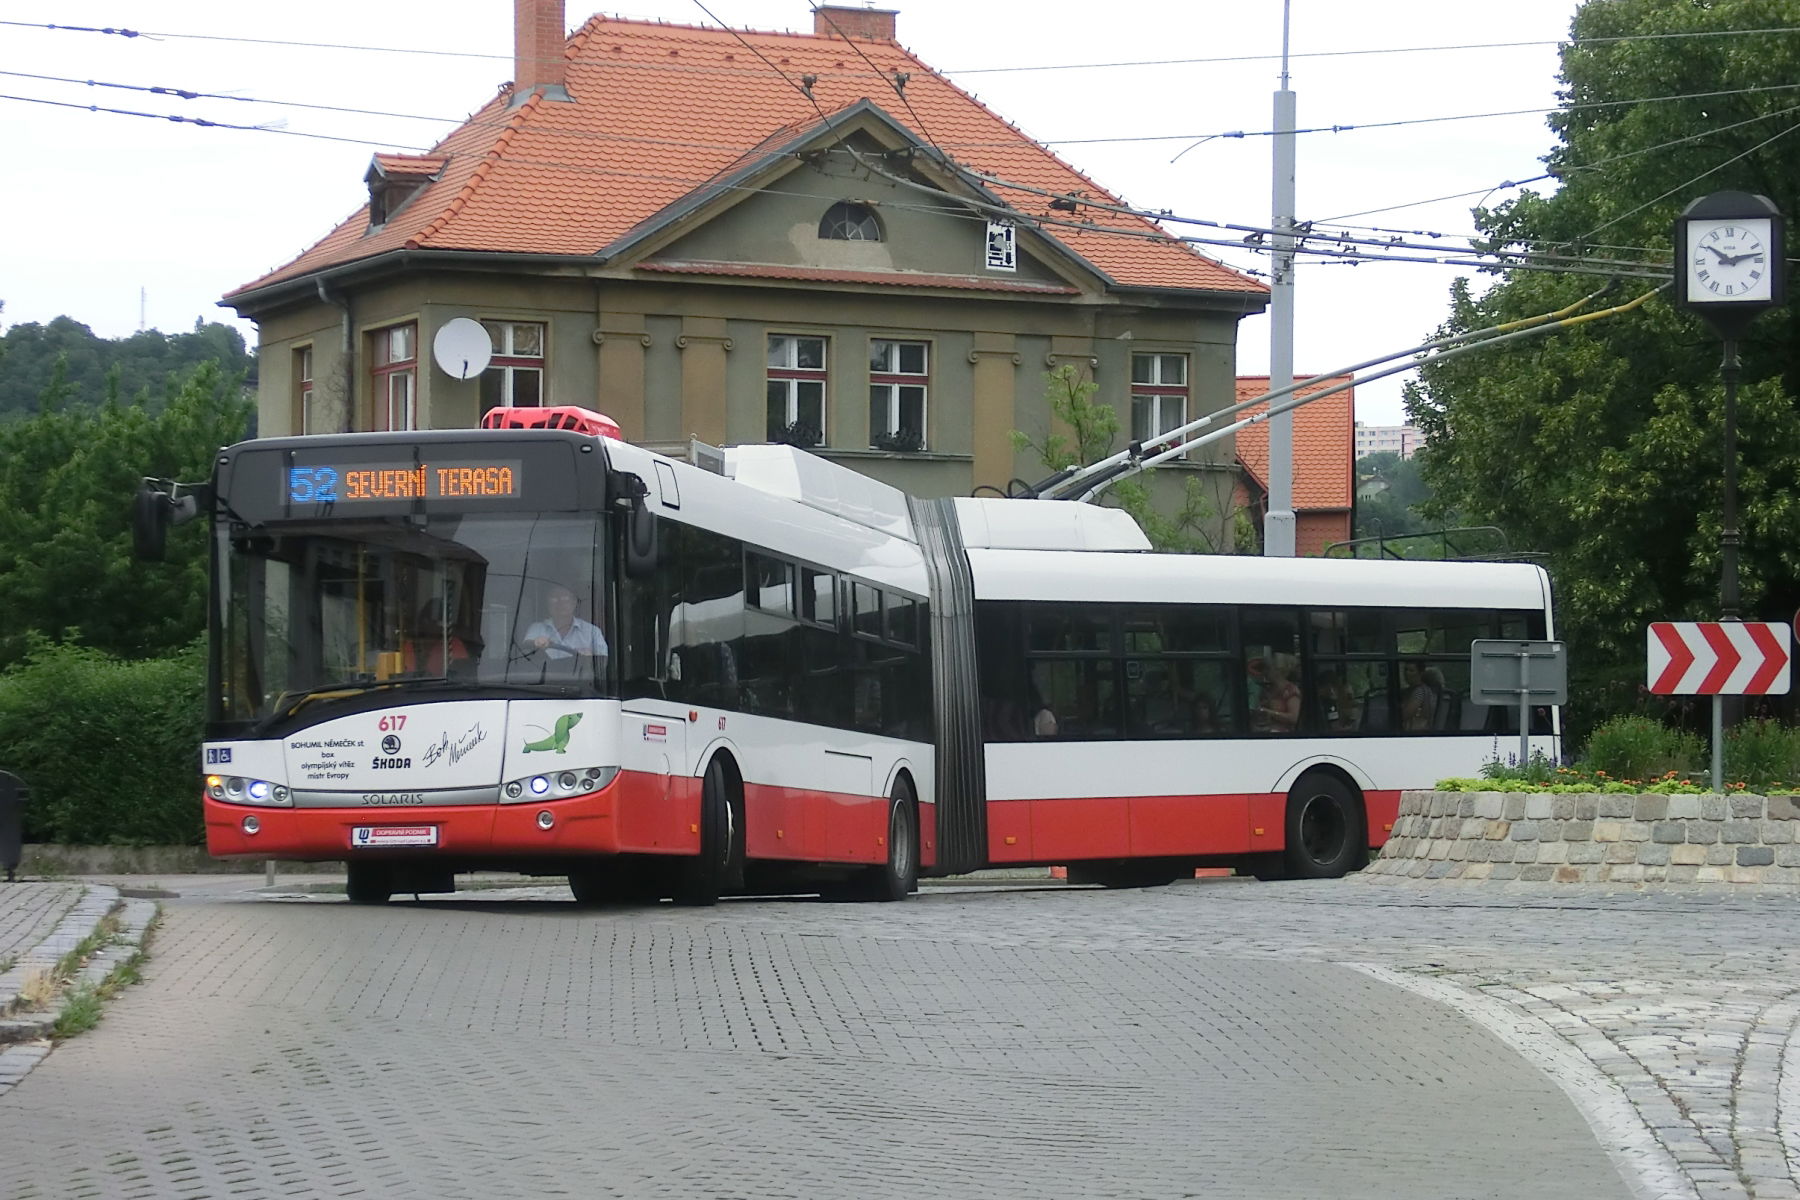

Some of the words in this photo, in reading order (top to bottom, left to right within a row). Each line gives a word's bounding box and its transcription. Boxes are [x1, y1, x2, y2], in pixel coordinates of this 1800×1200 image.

[290, 466, 338, 501] 52
[346, 464, 427, 498] SEVERNÍ
[437, 467, 513, 496] TERASA
[378, 714, 407, 732] 617
[290, 741, 322, 749] BOHUMIL
[372, 756, 412, 769] ŠKODA
[361, 793, 424, 805] SOLARIS
